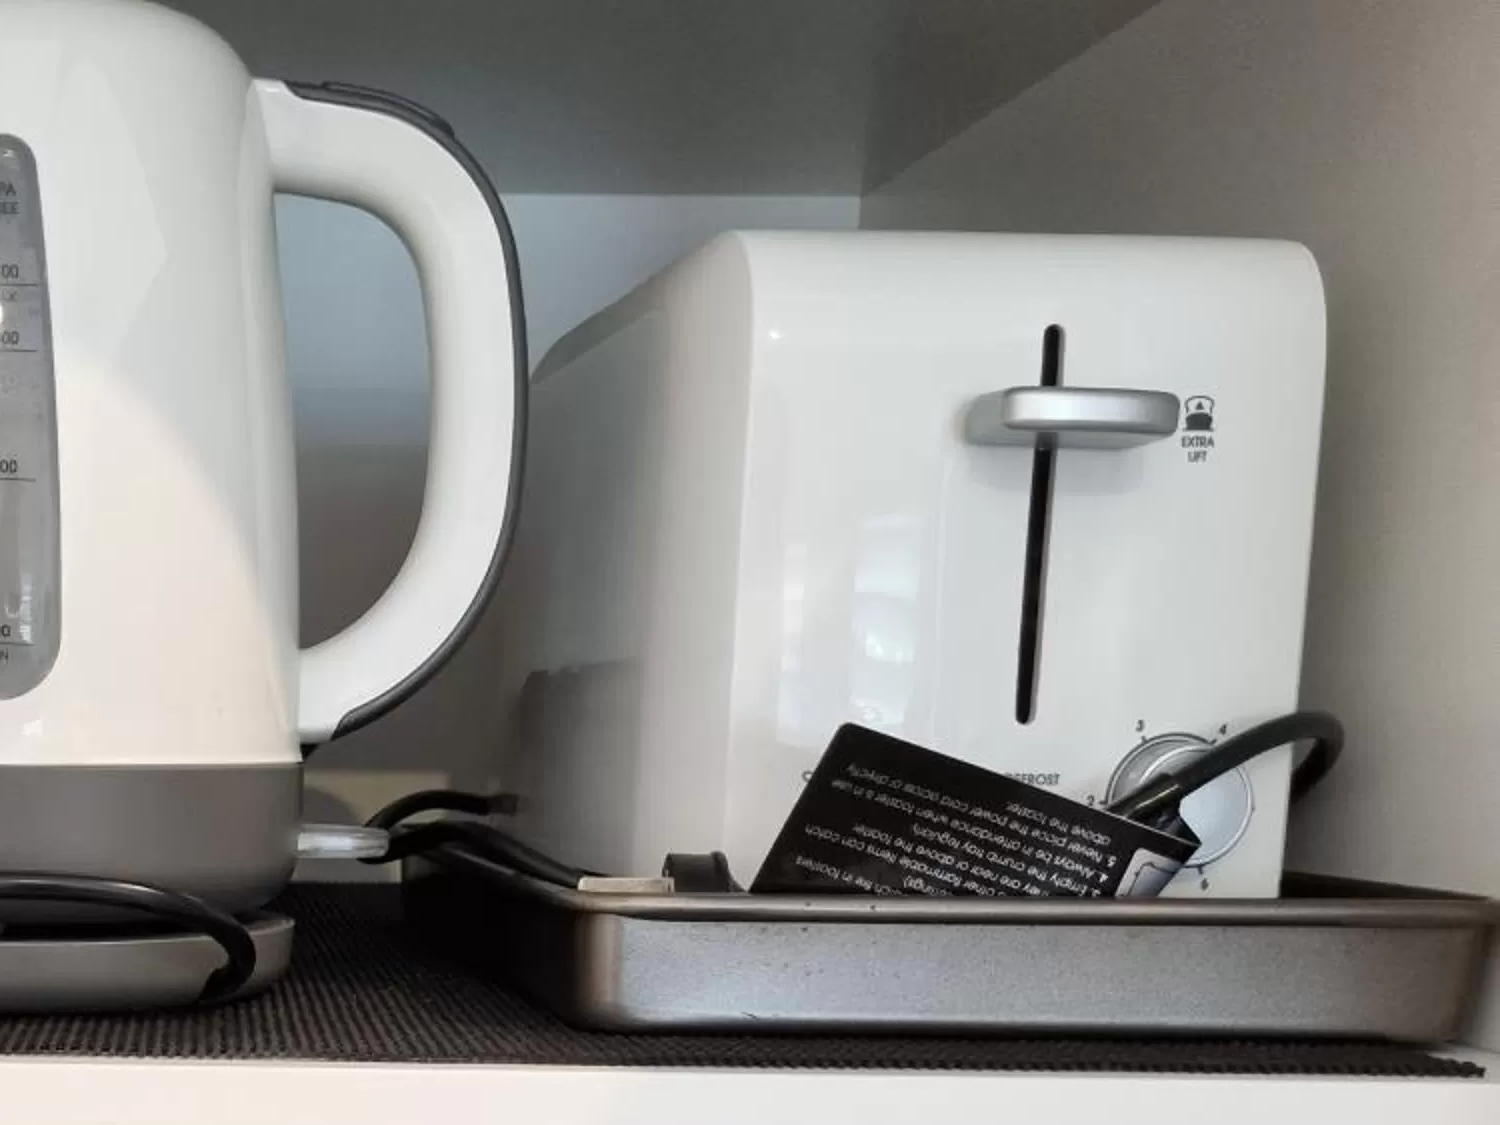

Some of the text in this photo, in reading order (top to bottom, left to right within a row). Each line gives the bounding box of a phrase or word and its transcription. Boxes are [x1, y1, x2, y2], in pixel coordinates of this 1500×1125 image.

[1181, 435, 1215, 449] EXTRA
[1135, 719, 1144, 732] 3
[1218, 723, 1227, 735] 4
